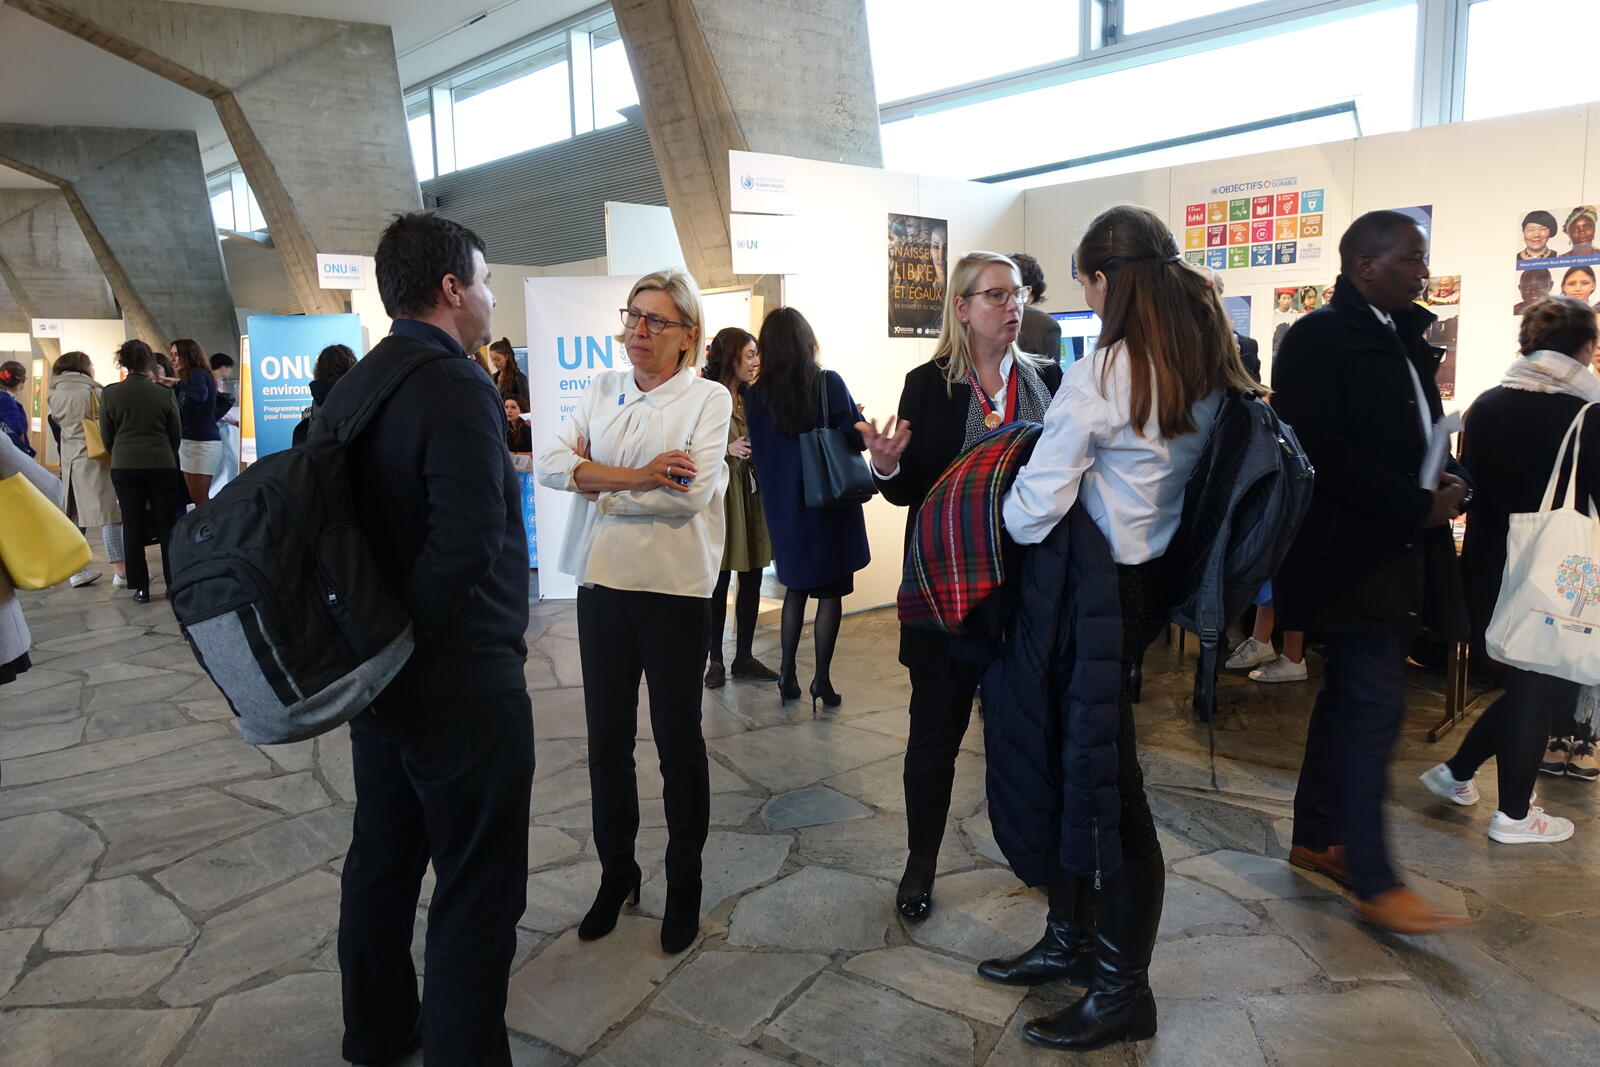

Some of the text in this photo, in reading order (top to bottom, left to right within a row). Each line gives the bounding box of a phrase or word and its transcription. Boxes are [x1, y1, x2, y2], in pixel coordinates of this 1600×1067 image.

[1219, 180, 1263, 194] OBJECTIFS
[746, 239, 758, 250] UN
[894, 245, 941, 262] NAISSE
[323, 263, 348, 274] ONU
[894, 283, 942, 300] ET ÉGAUX
[557, 335, 613, 370] UN
[261, 355, 319, 380] ONU
[262, 383, 312, 396] environ
[559, 375, 591, 391] envi
[263, 405, 300, 413] Programme
